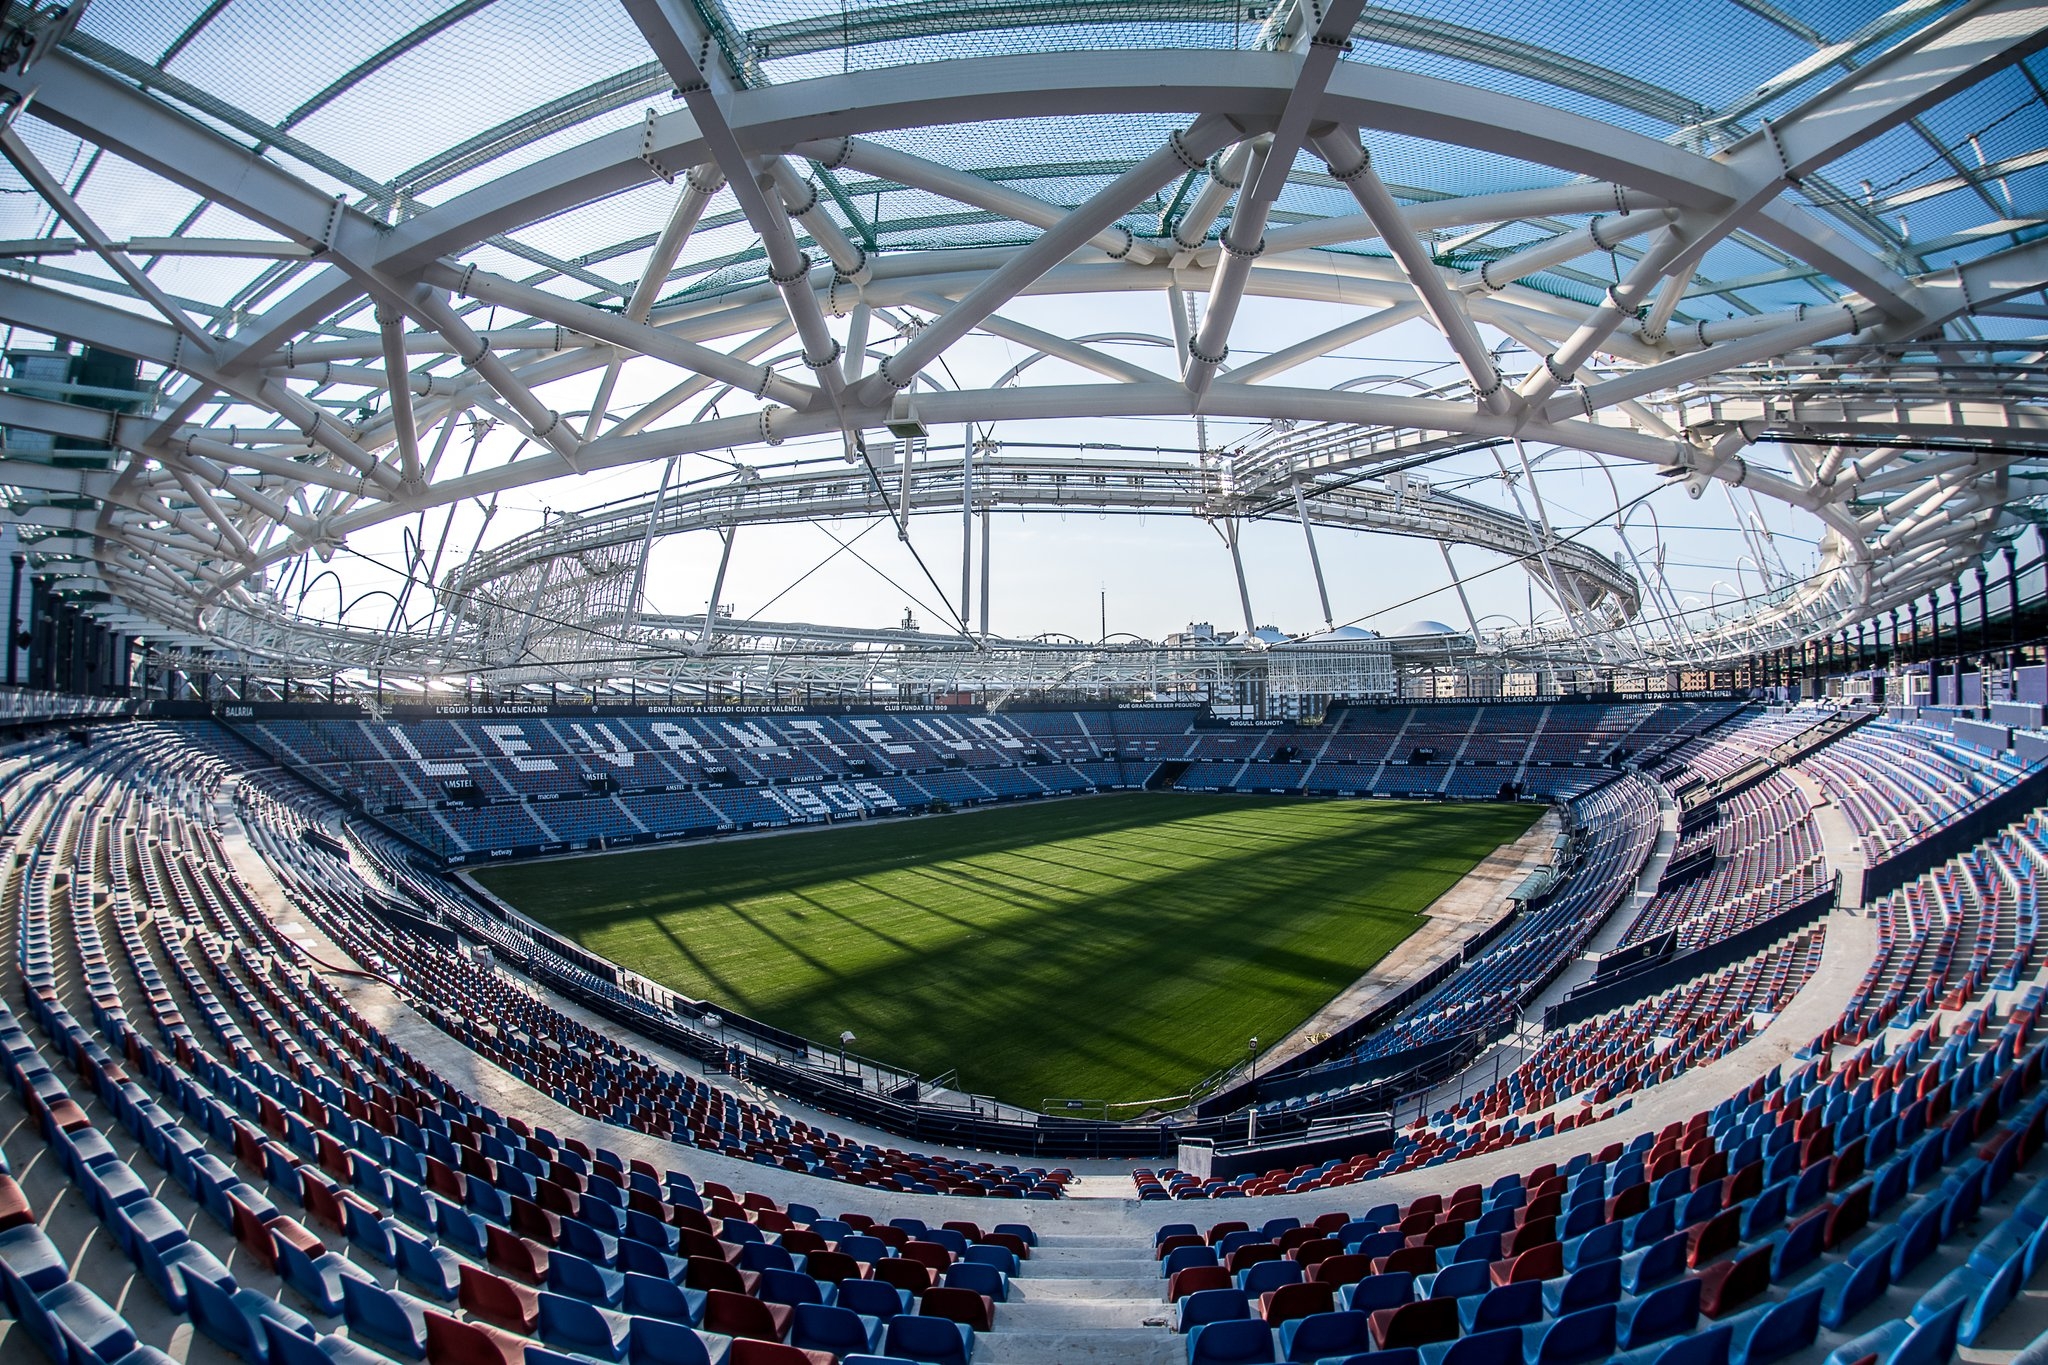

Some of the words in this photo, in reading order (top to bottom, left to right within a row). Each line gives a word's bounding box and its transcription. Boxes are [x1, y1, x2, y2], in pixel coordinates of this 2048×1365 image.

[472, 706, 493, 714] DELS
[388, 720, 916, 776] LEVANTE
[759, 783, 898, 817] 1909
[491, 849, 512, 857] betway
[448, 855, 465, 864] betway
